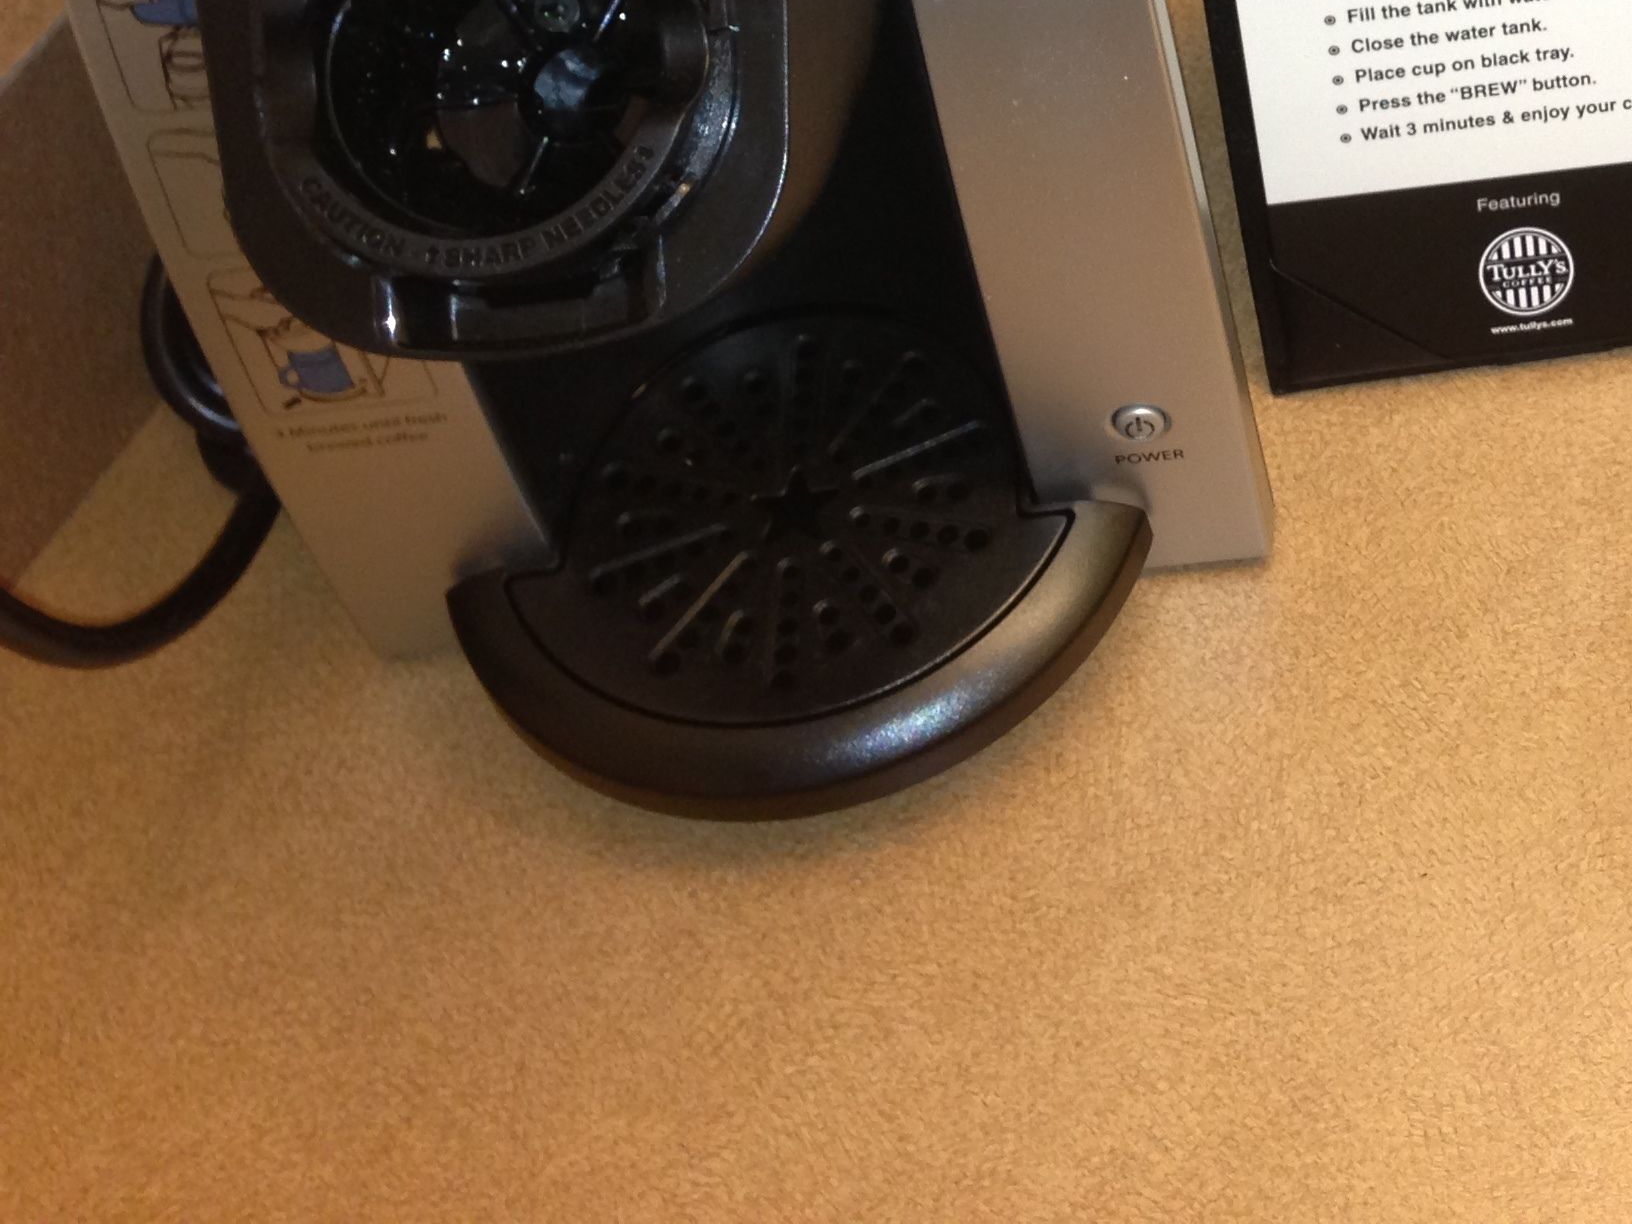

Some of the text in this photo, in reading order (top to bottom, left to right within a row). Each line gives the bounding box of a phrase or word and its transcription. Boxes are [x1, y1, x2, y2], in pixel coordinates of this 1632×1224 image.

[1347, 7, 1376, 23] Fill
[1381, 4, 1411, 19] the
[1351, 18, 1548, 53] Close the water tank.
[1355, 46, 1575, 83] Place cup on black tray.
[1359, 74, 1597, 112] Press the “BREW” button.
[1361, 124, 1401, 141] Wait
[1406, 122, 1417, 137] 3
[1423, 113, 1496, 135] minutes
[1502, 110, 1515, 125] &
[1521, 105, 1570, 126] enjoy
[1575, 100, 1617, 119] your
[1477, 192, 1560, 212] Featuring
[1486, 259, 1567, 281] TULLY'S
[1503, 276, 1552, 288] COFFEE
[1491, 318, 1573, 335] www.tullys.com
[1115, 449, 1184, 465] POWER
